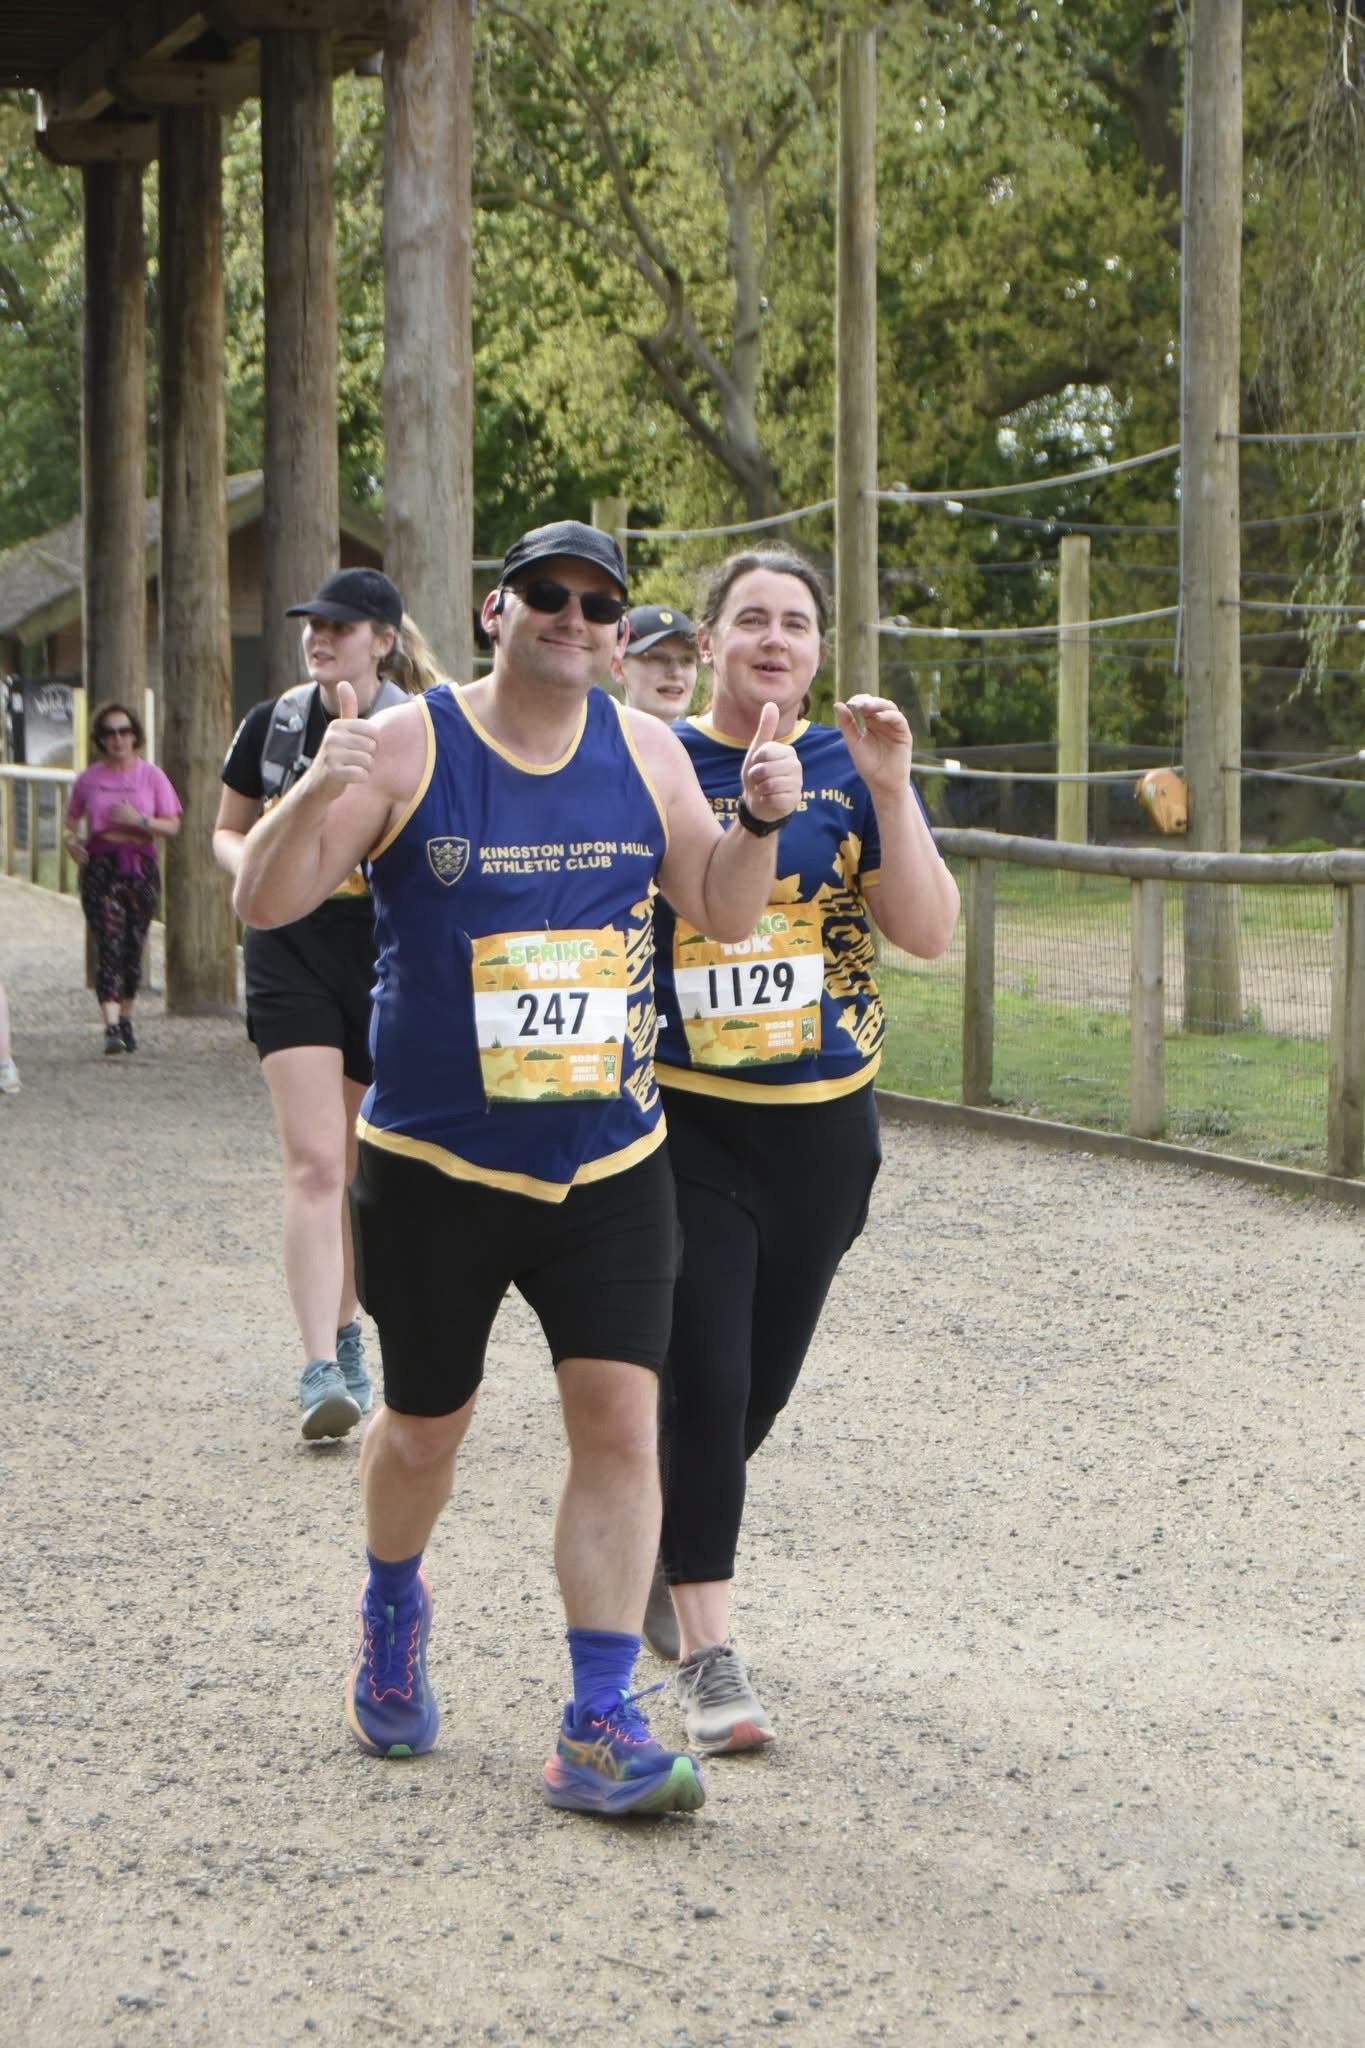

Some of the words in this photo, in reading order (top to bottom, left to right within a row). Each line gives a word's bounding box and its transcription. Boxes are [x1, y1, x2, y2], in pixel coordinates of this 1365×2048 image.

[821, 789, 854, 809] HULL
[479, 844, 564, 860] KINGSTON
[570, 841, 618, 856] UPON
[621, 841, 654, 857] HULL
[481, 857, 561, 874] ATHLETIC
[566, 855, 612, 871] CLUB
[508, 939, 598, 965] SPRING
[525, 960, 582, 981] 10K
[708, 961, 795, 1009] 1129
[517, 991, 590, 1037] 247
